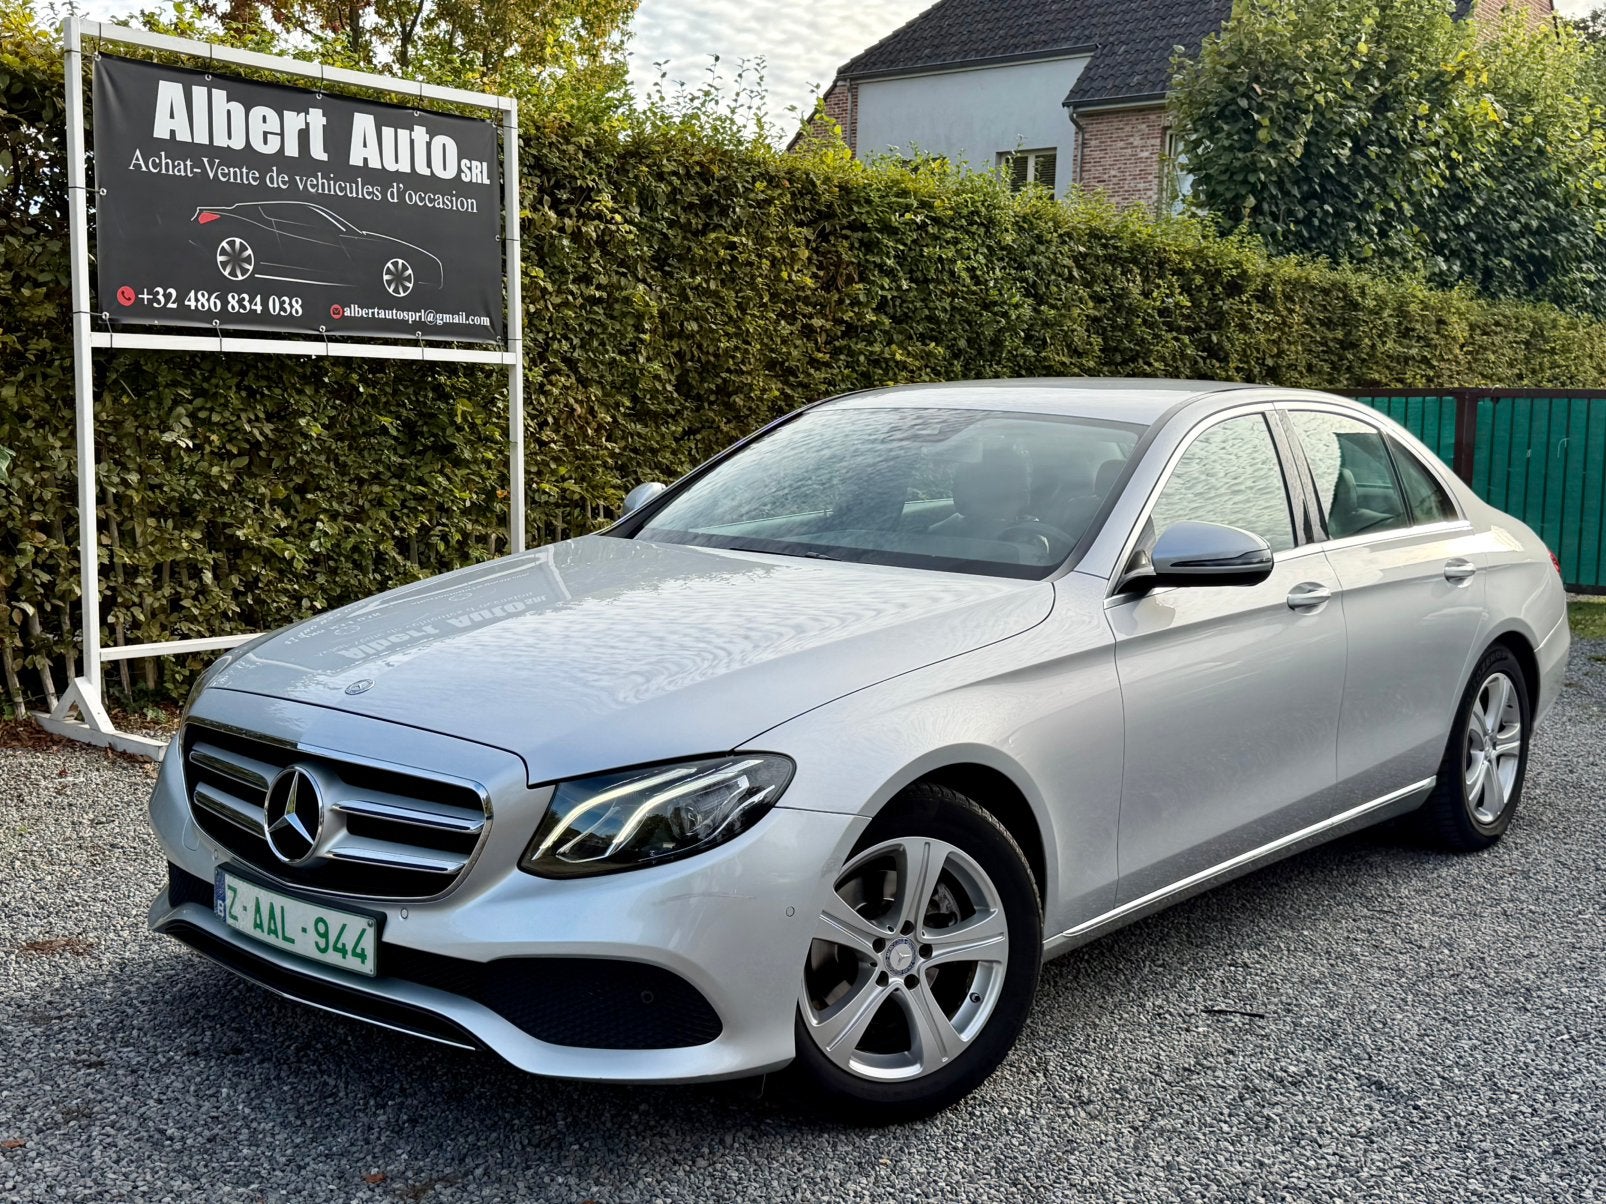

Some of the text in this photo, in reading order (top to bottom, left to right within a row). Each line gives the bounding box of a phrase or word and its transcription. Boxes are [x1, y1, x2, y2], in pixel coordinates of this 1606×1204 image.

[153, 80, 490, 185] Albert Auto SRL
[128, 148, 259, 186] Achat-Vente
[266, 166, 289, 189] de
[295, 172, 381, 201] vehicules
[138, 287, 302, 317] +32 486 834 038
[343, 304, 490, 326] albertautosprl@gmail.com
[216, 899, 224, 916] B
